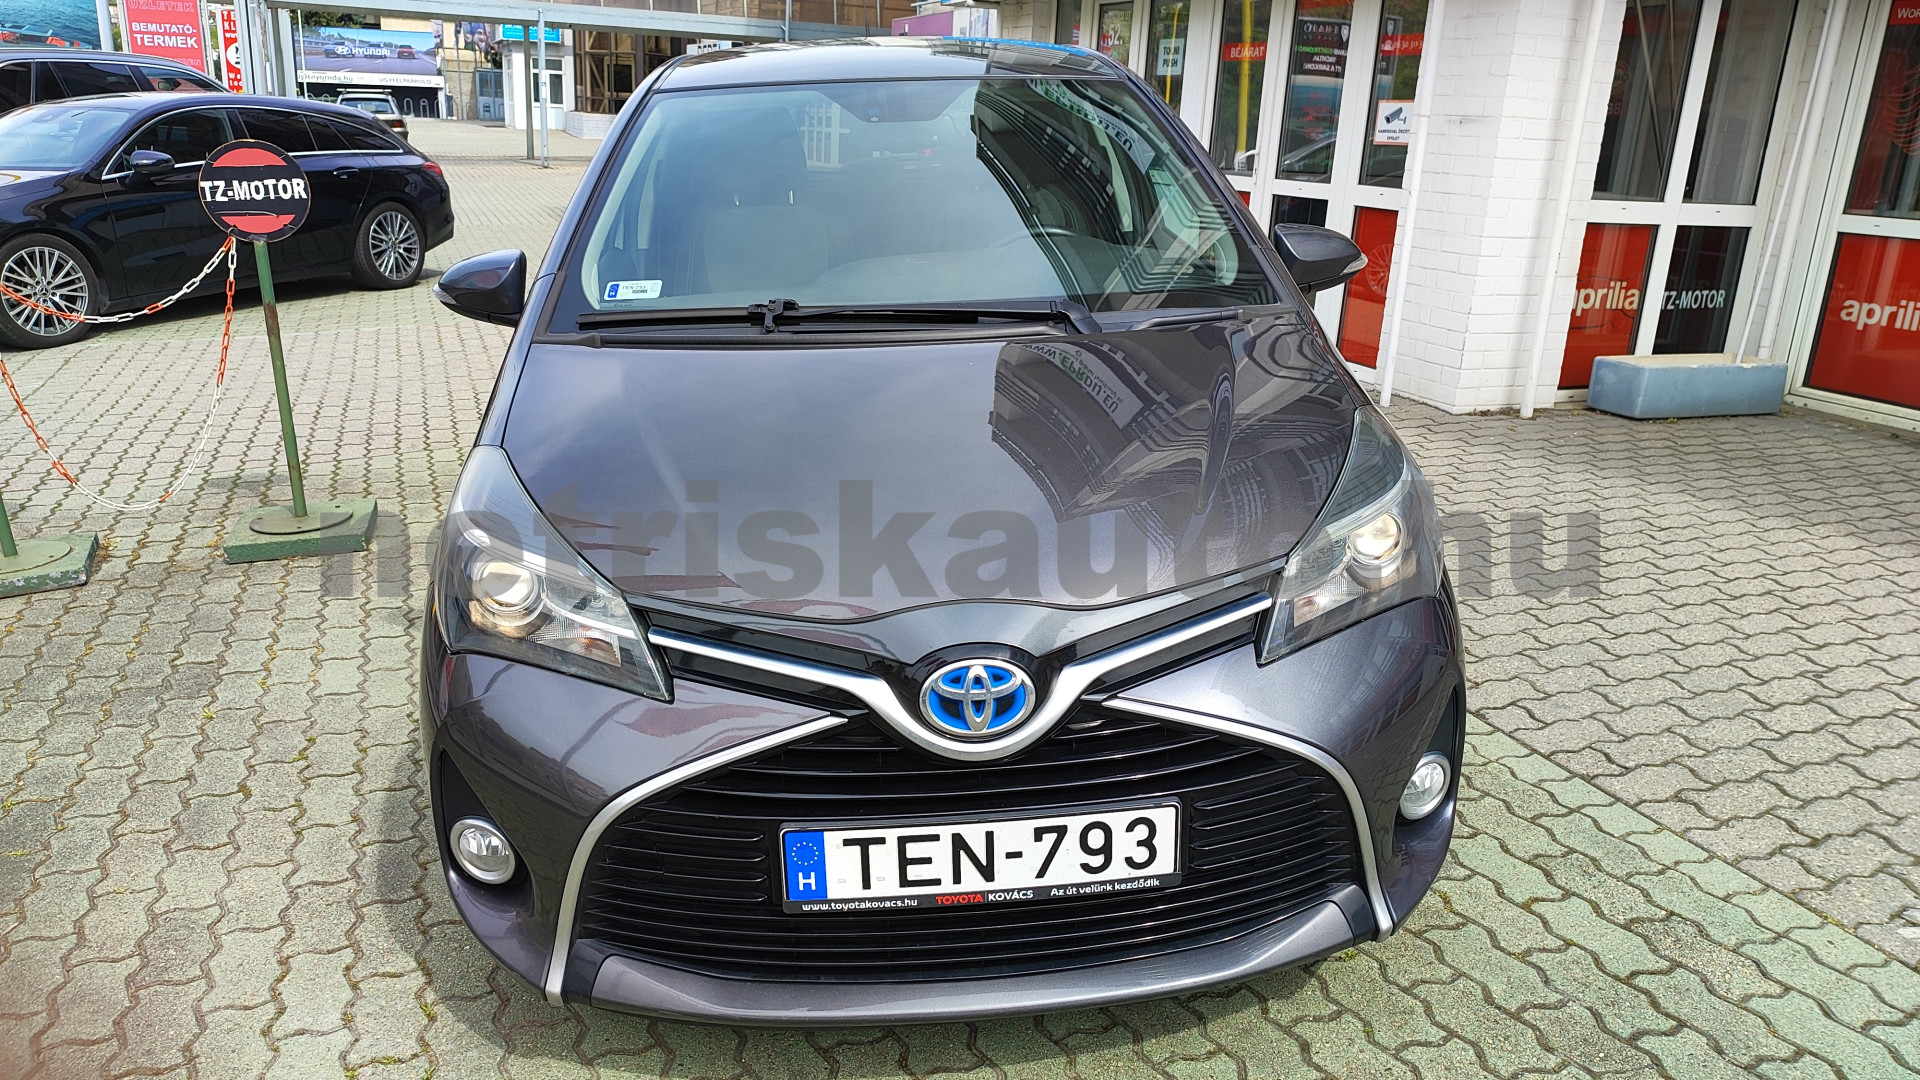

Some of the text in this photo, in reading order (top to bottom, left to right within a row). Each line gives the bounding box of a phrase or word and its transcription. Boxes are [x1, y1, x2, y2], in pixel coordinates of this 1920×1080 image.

[223, 11, 236, 20] TE
[131, 22, 197, 34] BEMUTATÓ-
[133, 34, 199, 48] TERMEK
[352, 47, 390, 56] HYUNDAI
[1163, 46, 1180, 55] TONI
[200, 178, 308, 202] TZ-MOTOR
[1661, 289, 1726, 310] TZ-MOTOR
[1840, 299, 1920, 332] aprili
[842, 816, 1158, 891] TEN-793
[798, 871, 816, 891] H
[935, 877, 1161, 905] TOYOTA KOVÁCS Az út velünk kezdődik
[802, 898, 918, 912] www.toyotakovacs.hu
